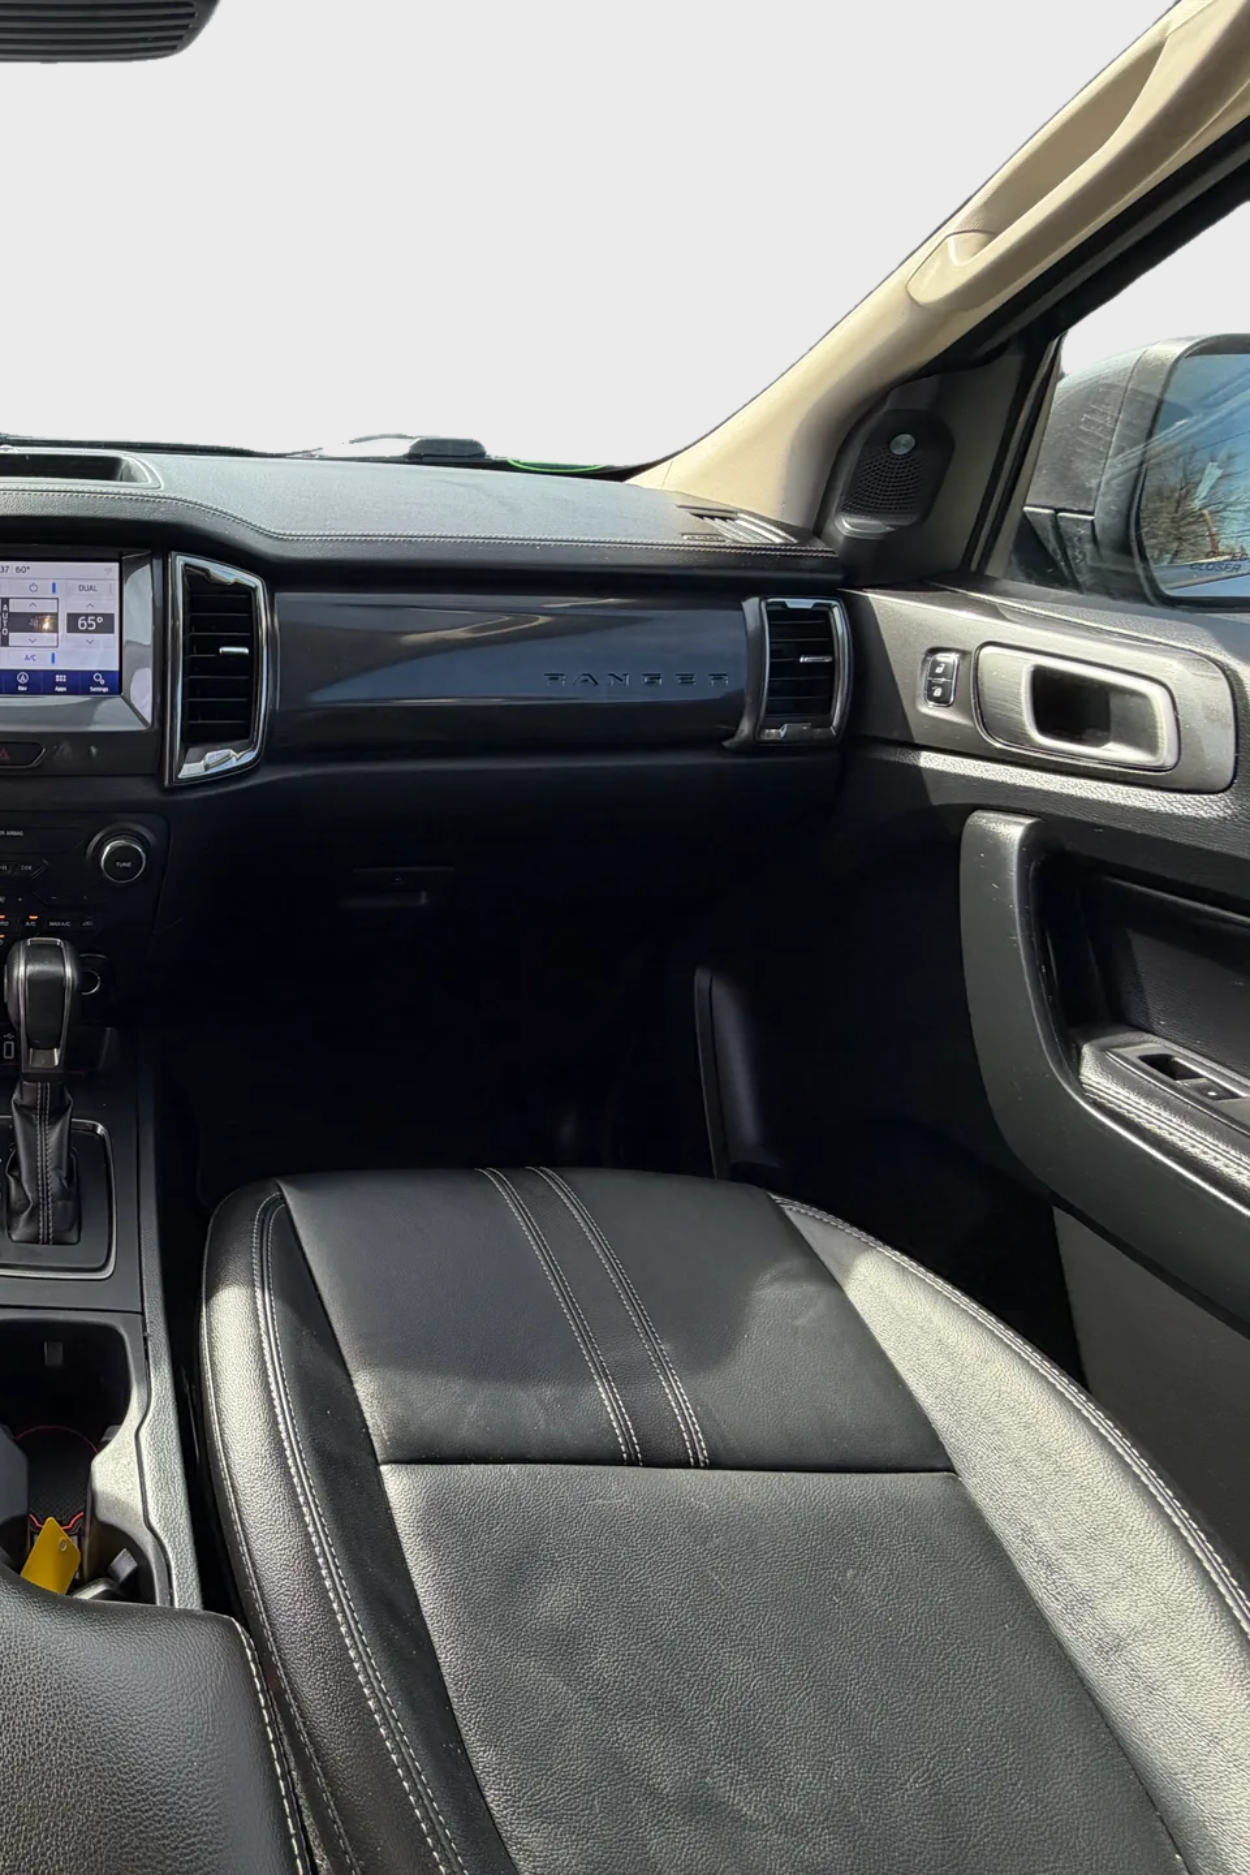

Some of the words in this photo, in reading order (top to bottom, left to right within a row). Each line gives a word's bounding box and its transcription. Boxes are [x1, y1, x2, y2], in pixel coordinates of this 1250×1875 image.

[15, 565, 31, 574] 60°
[78, 584, 98, 592] DUAL
[77, 616, 104, 630] 65°
[24, 654, 37, 662] A/C
[544, 672, 729, 687] RANGER
